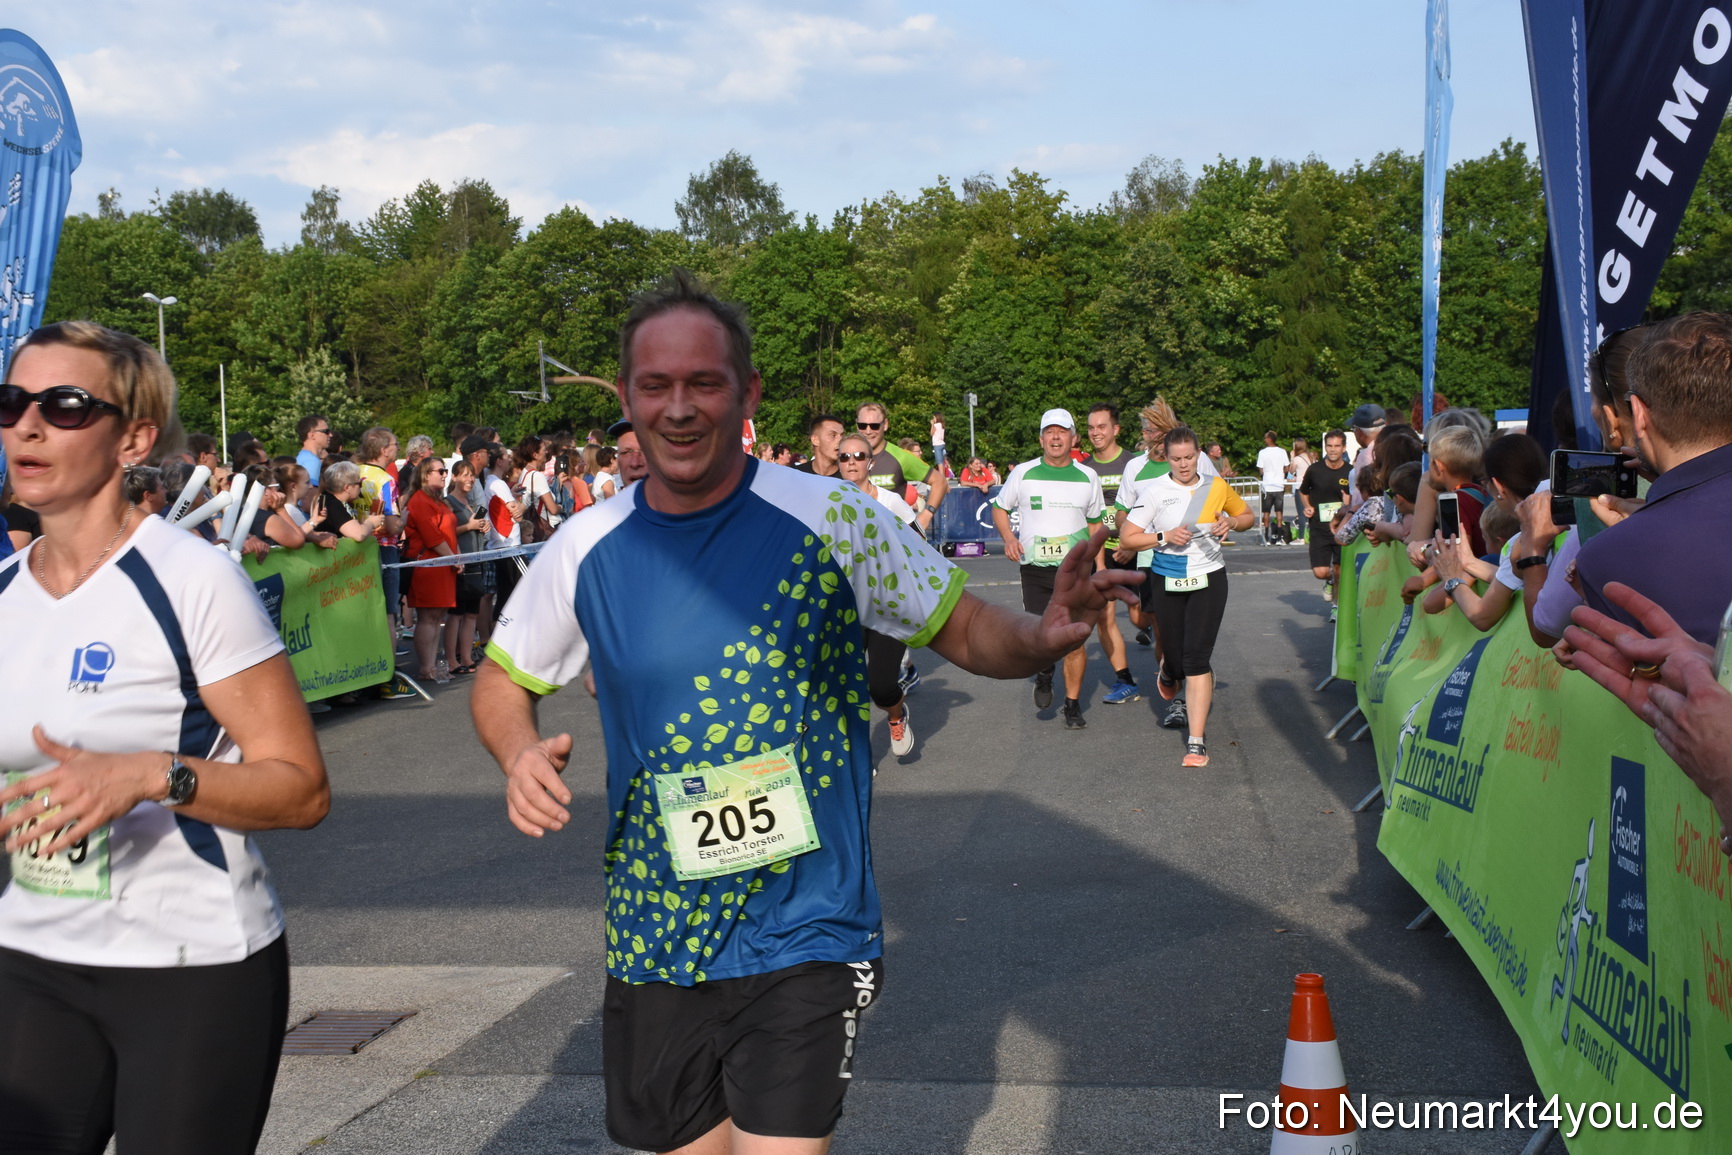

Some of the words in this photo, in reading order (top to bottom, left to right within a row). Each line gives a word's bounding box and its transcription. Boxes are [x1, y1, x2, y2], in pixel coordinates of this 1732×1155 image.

[1041, 545, 1062, 555] 114
[1174, 578, 1199, 587] 618
[284, 612, 312, 654] lauf
[1447, 666, 1471, 686] Fischer
[1403, 725, 1491, 811] firmenlauf
[766, 776, 791, 792] 2019
[691, 795, 776, 848] 205
[1396, 794, 1431, 822] neumarkt
[698, 845, 740, 860] Essrich
[741, 833, 785, 851] Torsten
[1615, 815, 1641, 856] Fischer
[719, 852, 756, 865] Bionorica
[756, 848, 768, 856] SE
[1617, 855, 1639, 876] AUTOMOBILE
[1580, 911, 1692, 1096] firmenlauf
[1573, 1022, 1619, 1086] neumarkt
